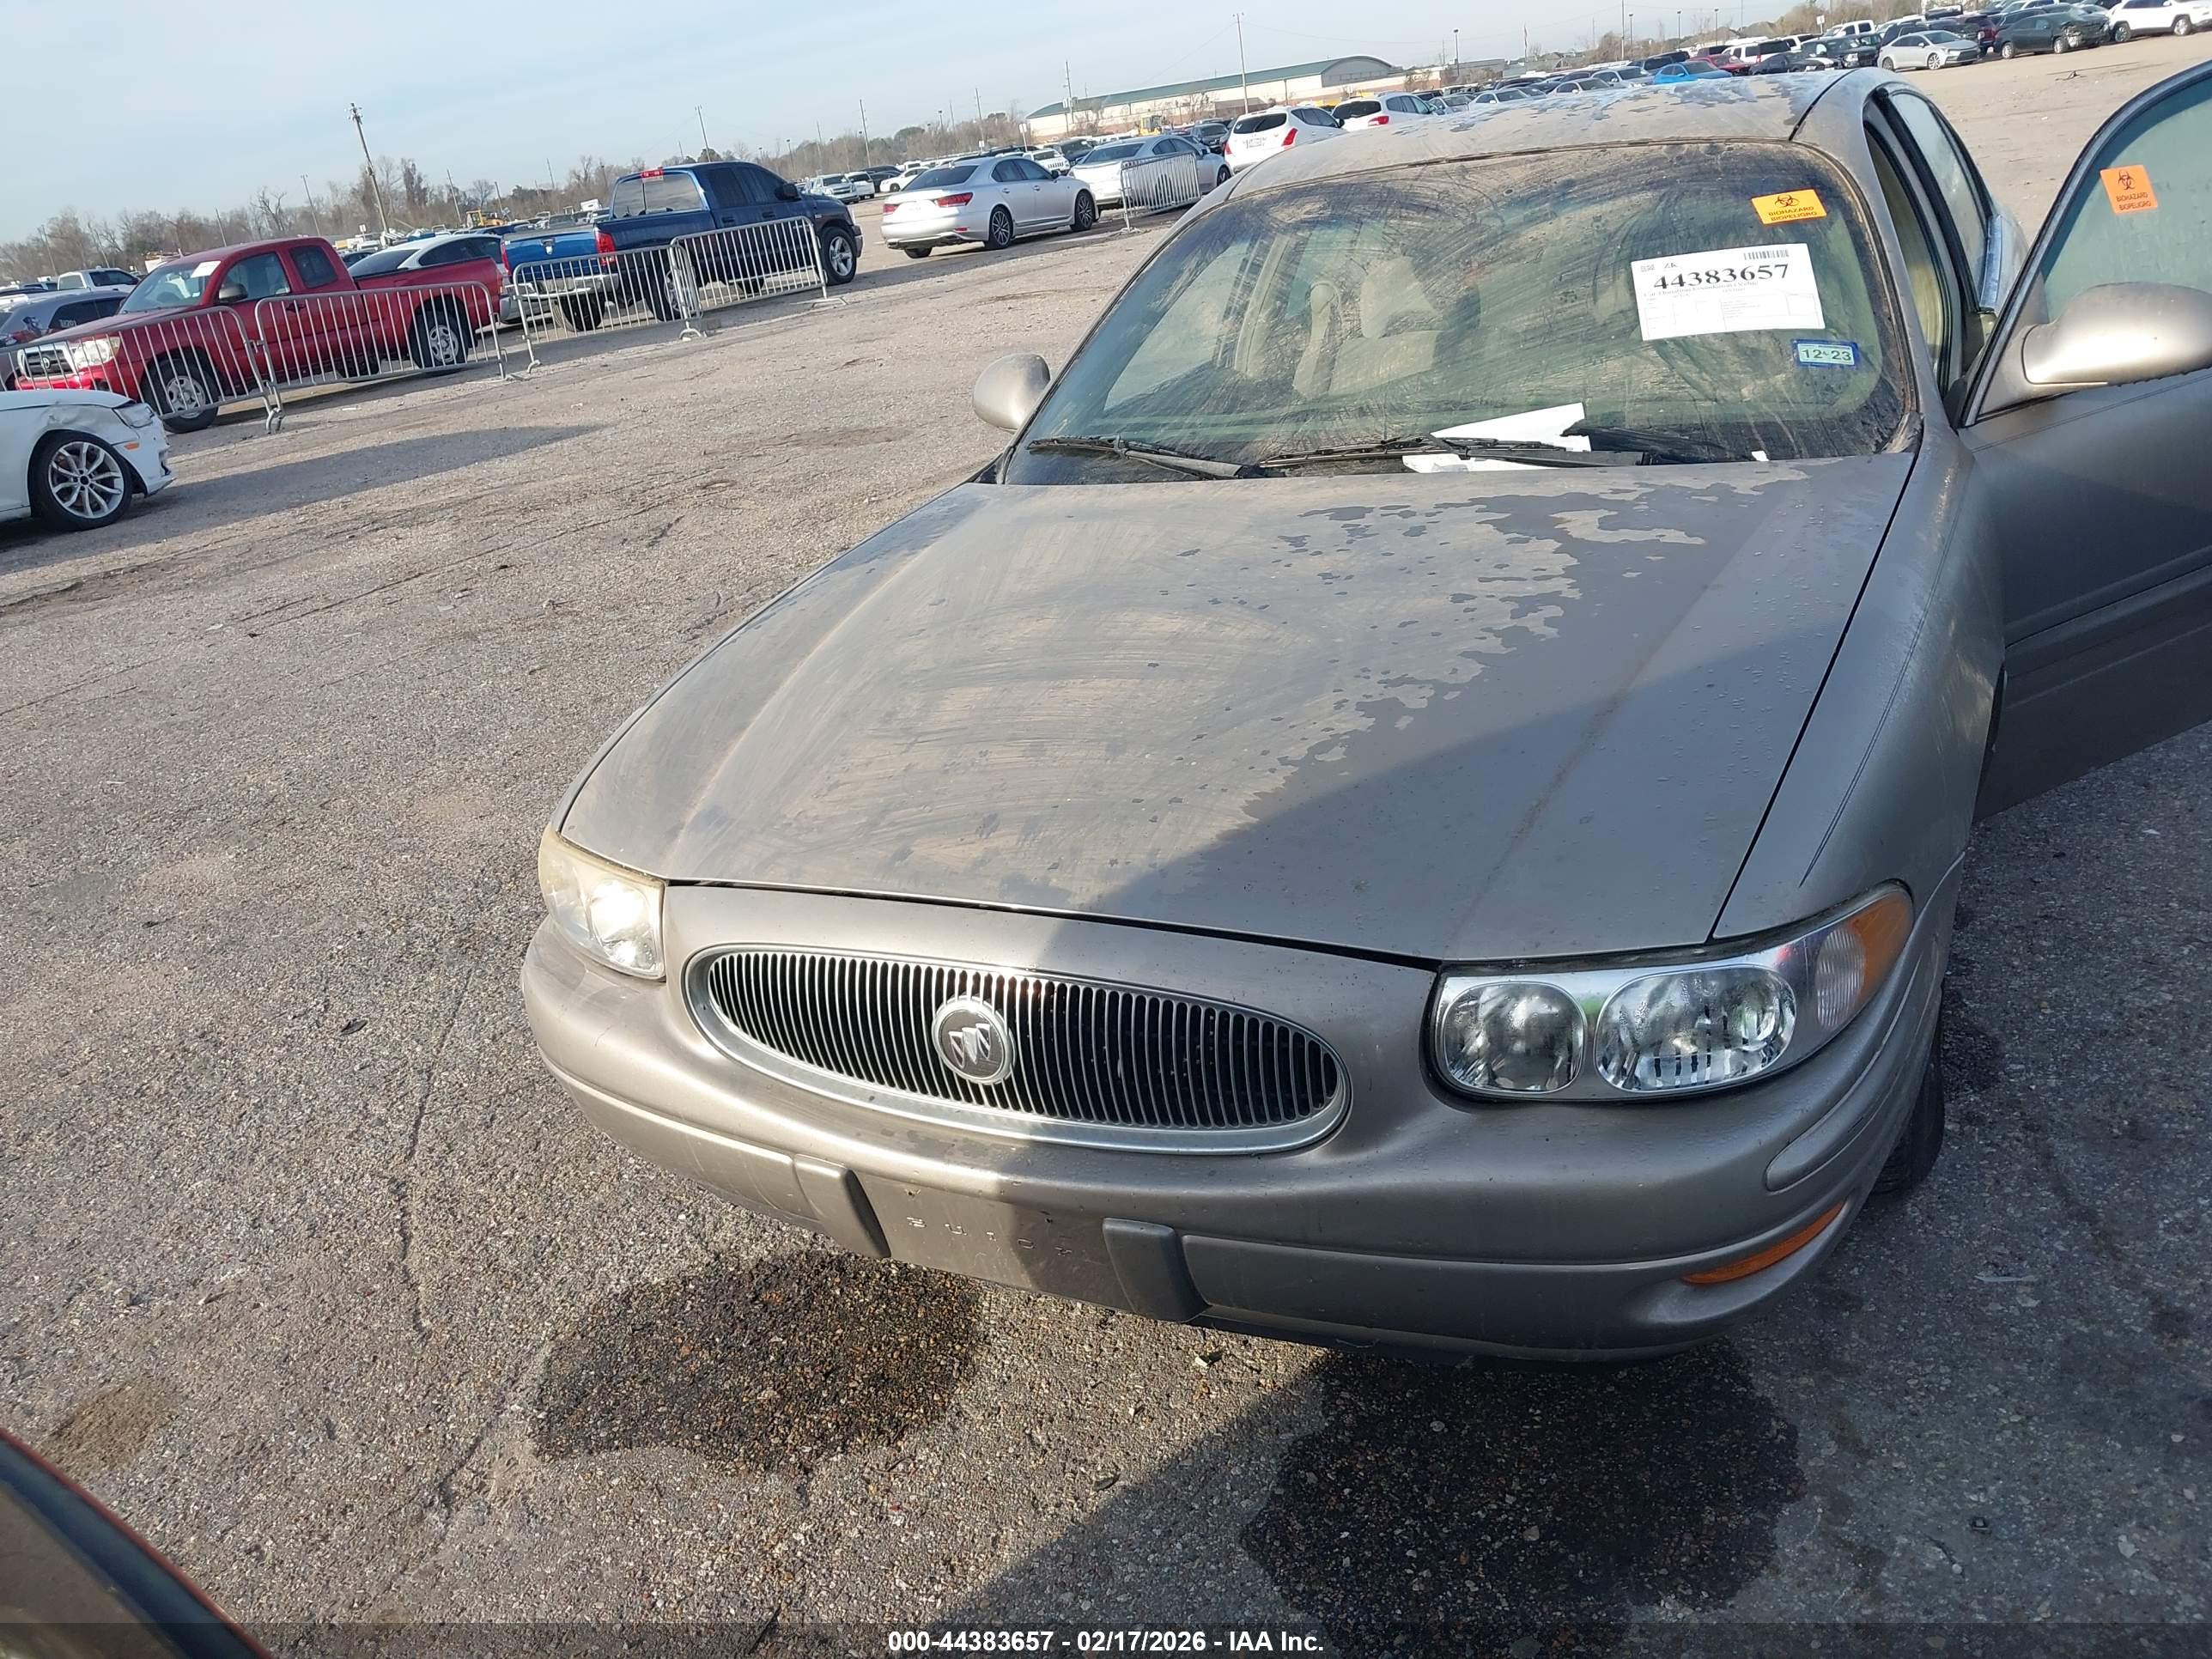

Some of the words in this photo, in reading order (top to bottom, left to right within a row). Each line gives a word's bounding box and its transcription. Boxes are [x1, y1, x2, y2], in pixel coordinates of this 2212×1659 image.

[1768, 206, 1814, 216] BIOHAZARD
[1771, 211, 1818, 221] BIOPELIGRO
[1654, 263, 1790, 289] 44383657
